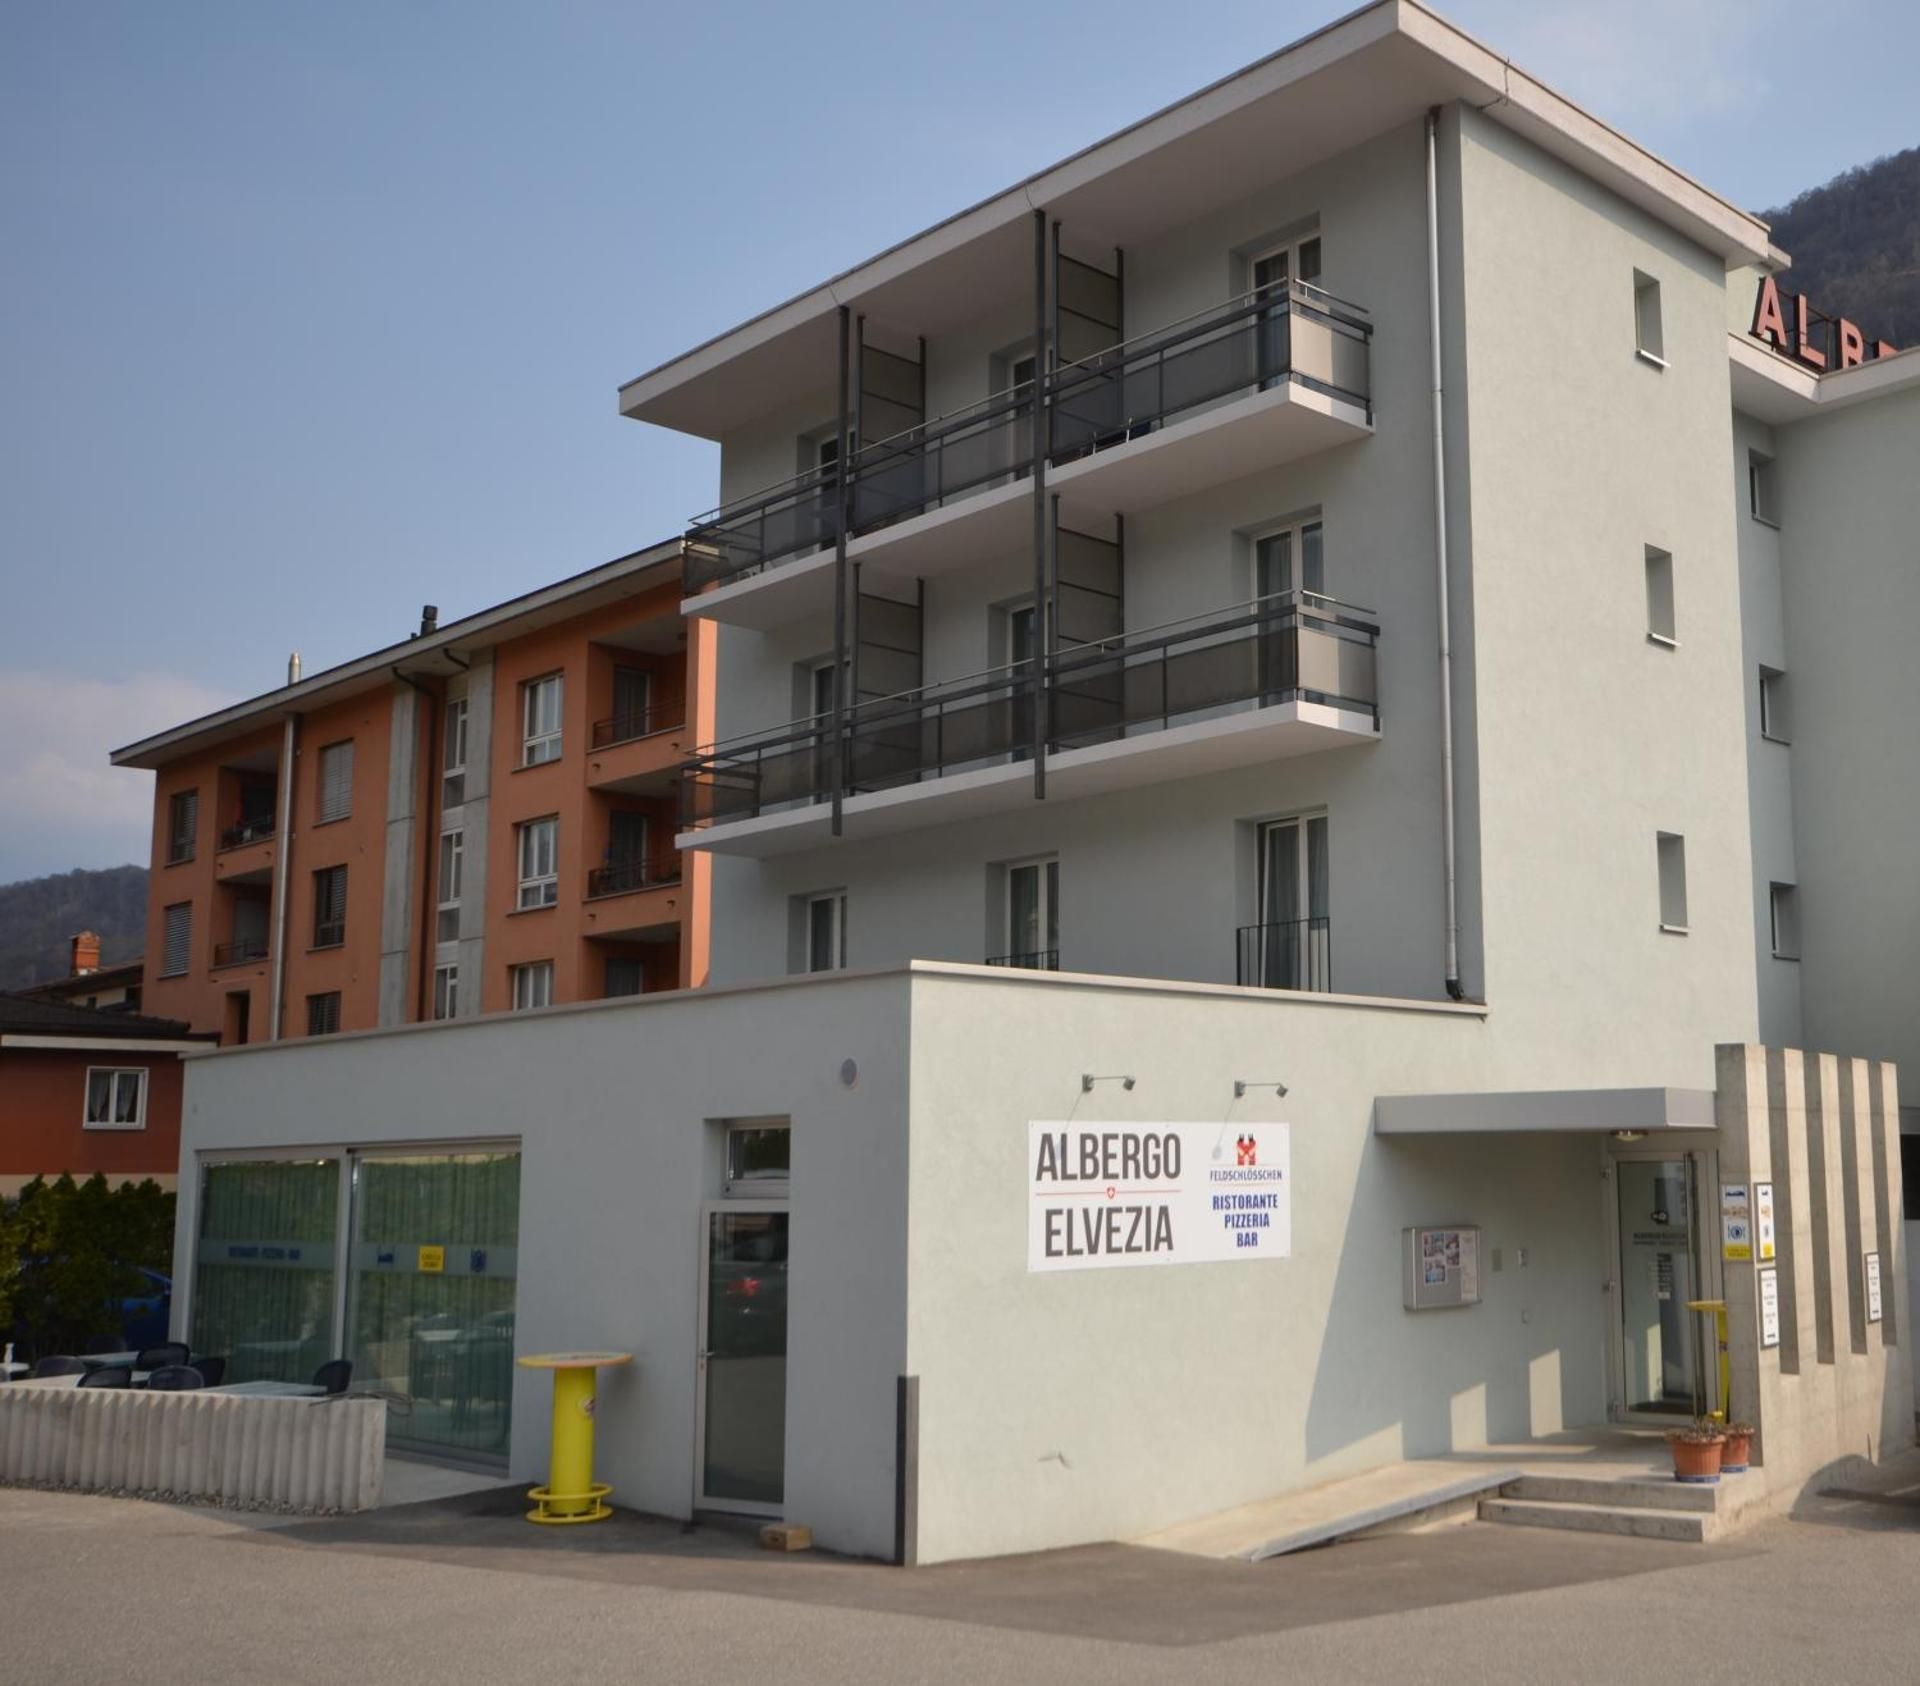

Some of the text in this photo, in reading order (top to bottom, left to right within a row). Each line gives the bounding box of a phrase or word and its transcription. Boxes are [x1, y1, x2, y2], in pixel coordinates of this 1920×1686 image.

[1036, 1132, 1181, 1181] ALBERGO
[1210, 1169, 1283, 1181] FELDSCHLÖSSCHEN
[1212, 1194, 1278, 1211] RISTORANTE
[1224, 1213, 1270, 1229] PIZZERIA
[1045, 1205, 1174, 1257] ELVEZIA
[1236, 1232, 1258, 1248] BAR
